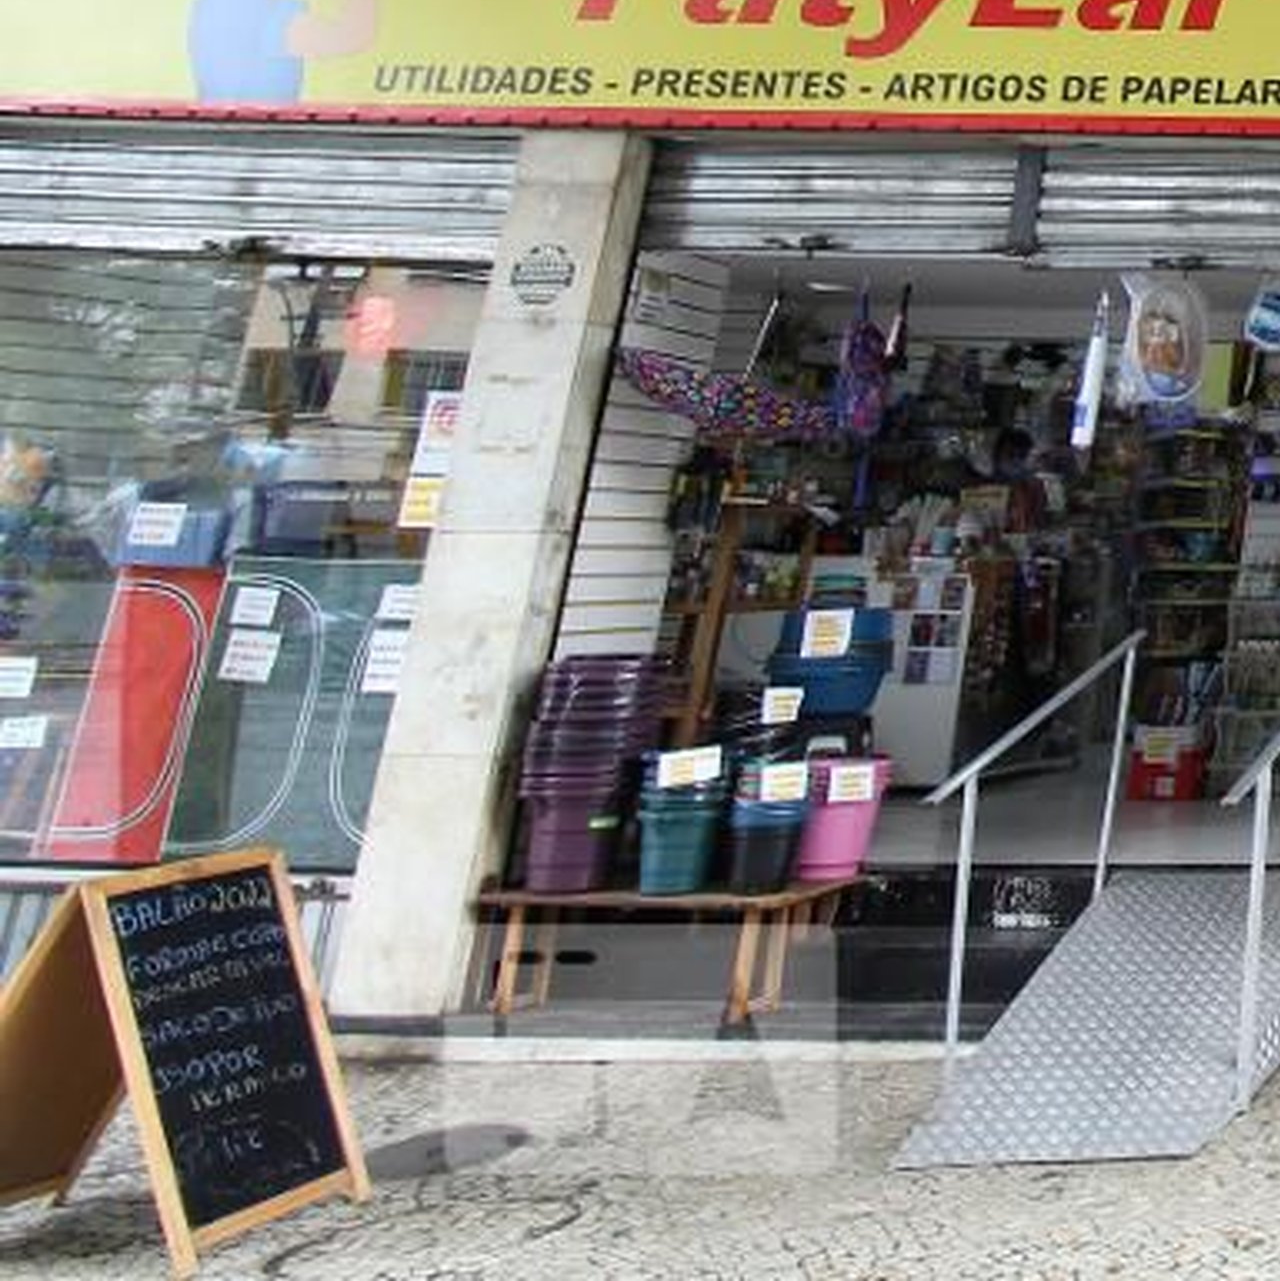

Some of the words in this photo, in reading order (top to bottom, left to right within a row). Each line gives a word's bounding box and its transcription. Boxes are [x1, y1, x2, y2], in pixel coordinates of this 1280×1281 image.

[373, 64, 593, 96] UTILIDADES
[630, 67, 848, 101] PRESENTES
[884, 71, 1049, 104] ARTIGOS
[1061, 74, 1109, 105] DE
